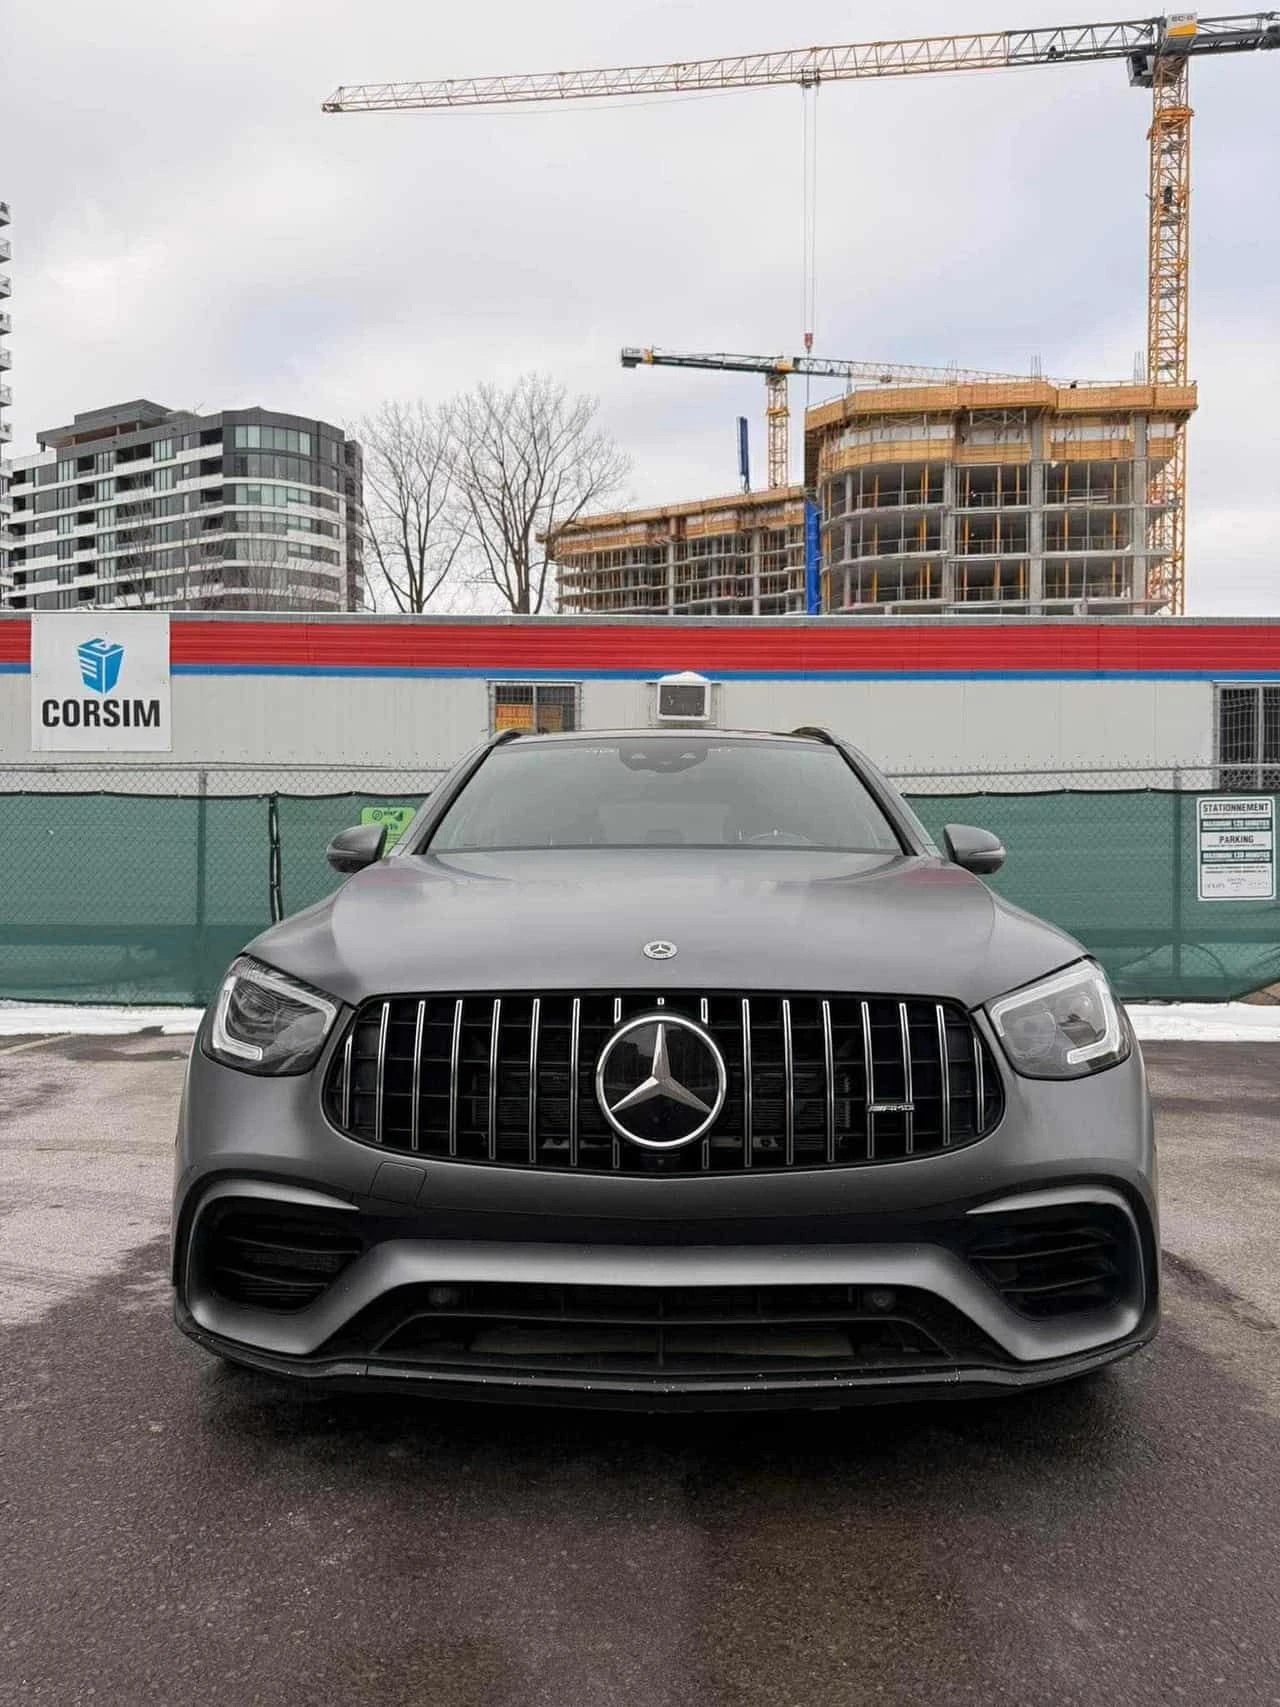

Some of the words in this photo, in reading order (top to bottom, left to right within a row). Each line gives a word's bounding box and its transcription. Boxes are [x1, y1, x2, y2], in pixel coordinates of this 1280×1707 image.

[42, 699, 161, 728] CORSIM
[1203, 802, 1269, 812] STATIONNEMENT
[1219, 834, 1254, 844] PARKING
